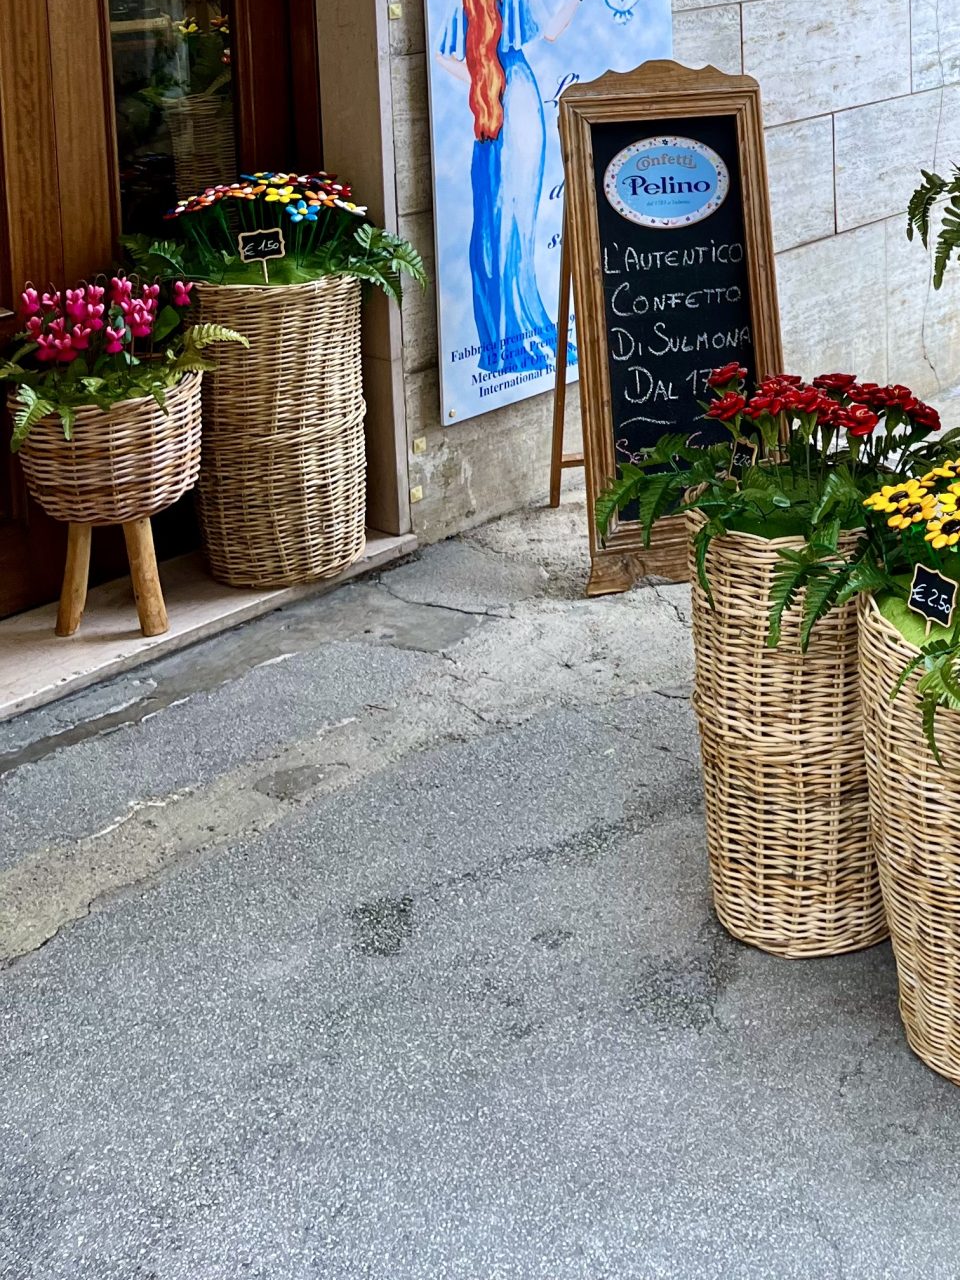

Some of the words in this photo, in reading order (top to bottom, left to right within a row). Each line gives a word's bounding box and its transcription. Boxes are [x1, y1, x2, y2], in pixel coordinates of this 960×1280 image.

[636, 153, 697, 171] Confetti
[622, 175, 711, 196] Pelino
[450, 342, 497, 363] Fabbrica
[500, 327, 543, 350] premiata
[500, 346, 526, 361] Gran
[471, 364, 518, 386] Mercurio
[479, 370, 542, 397] International
